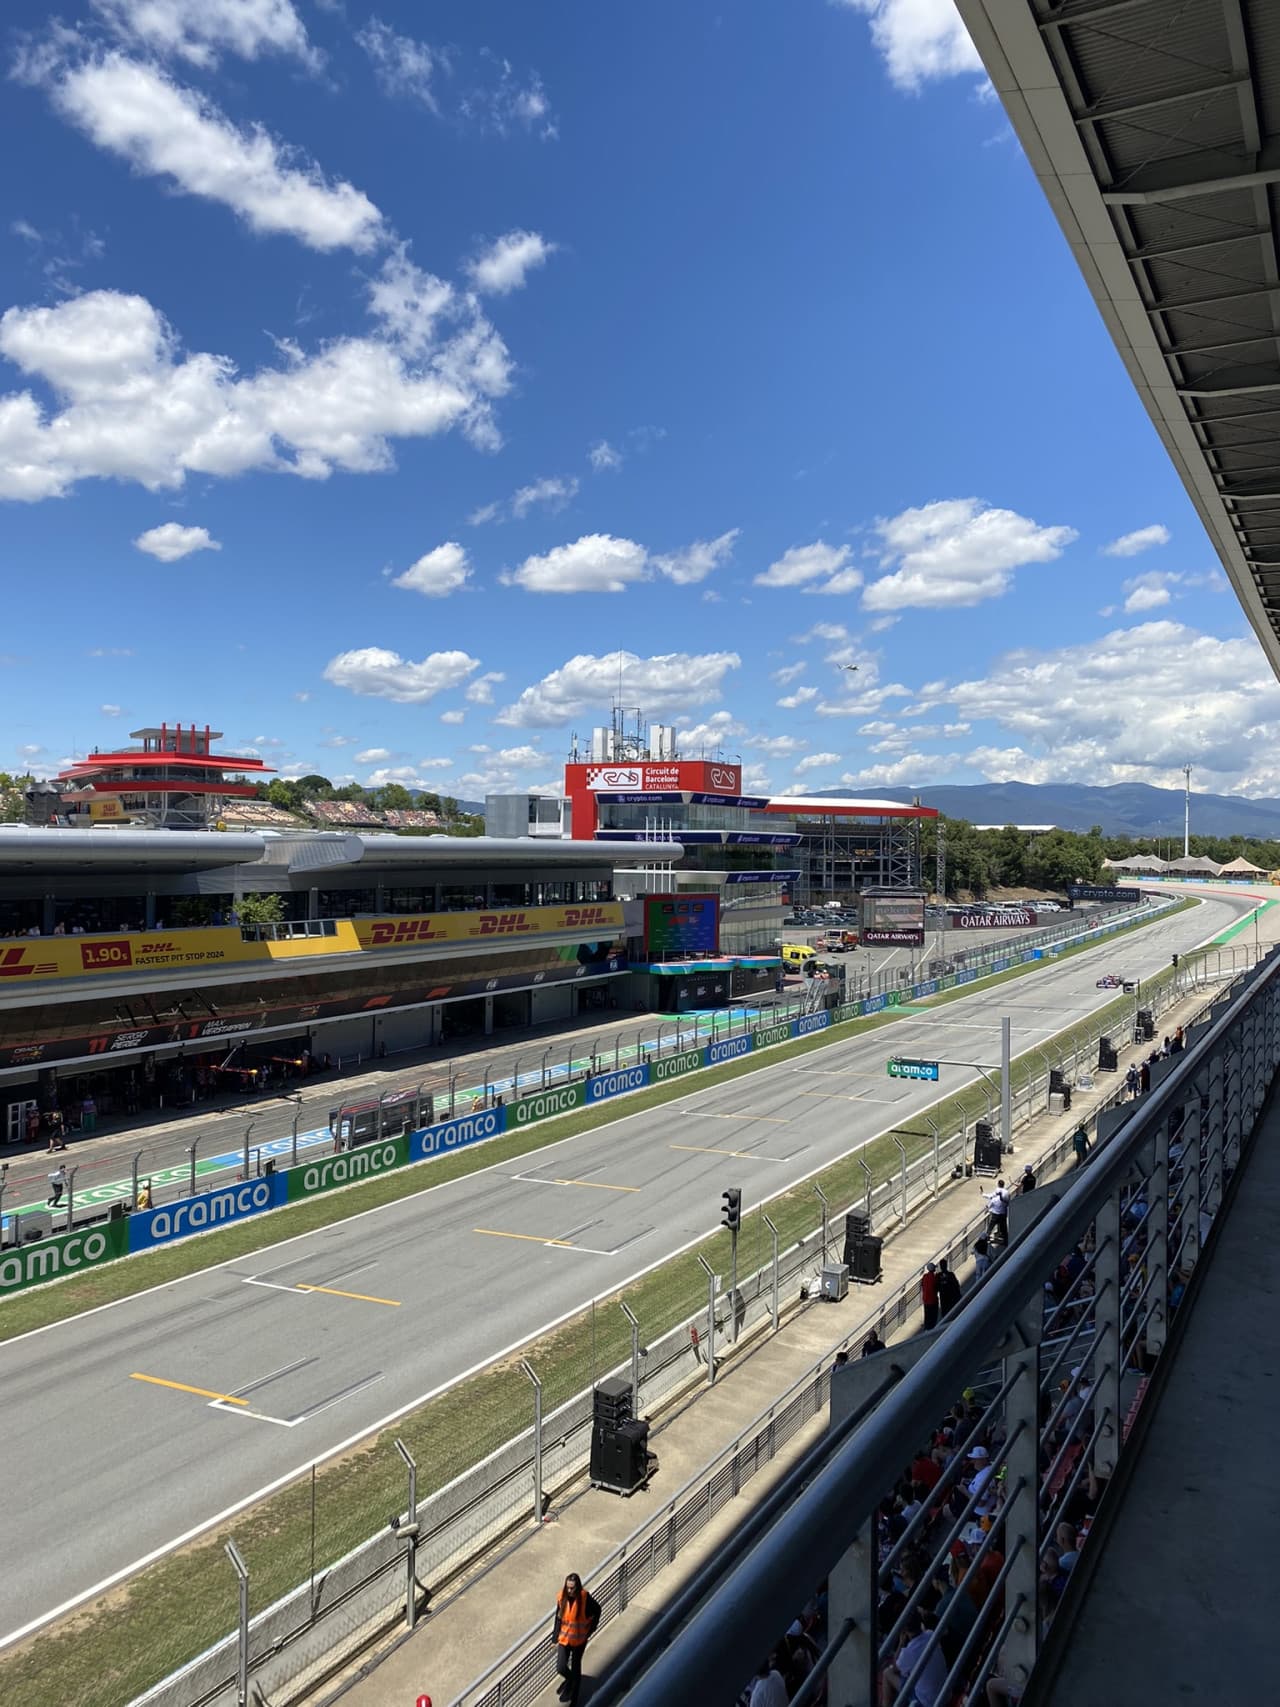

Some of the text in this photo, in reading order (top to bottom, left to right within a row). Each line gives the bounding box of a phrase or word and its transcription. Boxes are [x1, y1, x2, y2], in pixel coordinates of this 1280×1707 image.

[645, 767, 680, 775] Circuit de
[645, 775, 679, 783] Barcelona
[1082, 889, 1137, 899] crypto.com
[479, 913, 530, 935] DHL
[564, 908, 609, 927] DHL
[960, 912, 1031, 928] QATAR AIRWAYS
[371, 920, 435, 945] DHL
[867, 932, 919, 941] QATAR AIRWAYS
[135, 950, 225, 965] FASTEST PIT STOP 2024
[141, 942, 175, 954] DHL
[799, 1014, 828, 1033] aramco
[756, 1026, 789, 1047] aramco
[710, 1037, 747, 1061] aramco
[656, 1051, 699, 1078] aramco
[891, 1064, 933, 1076] aramco
[593, 1068, 643, 1098] aramco
[516, 1088, 577, 1122] aramco
[421, 1113, 496, 1154] aramco
[303, 1144, 397, 1191] aramco
[150, 1182, 271, 1239] aramco
